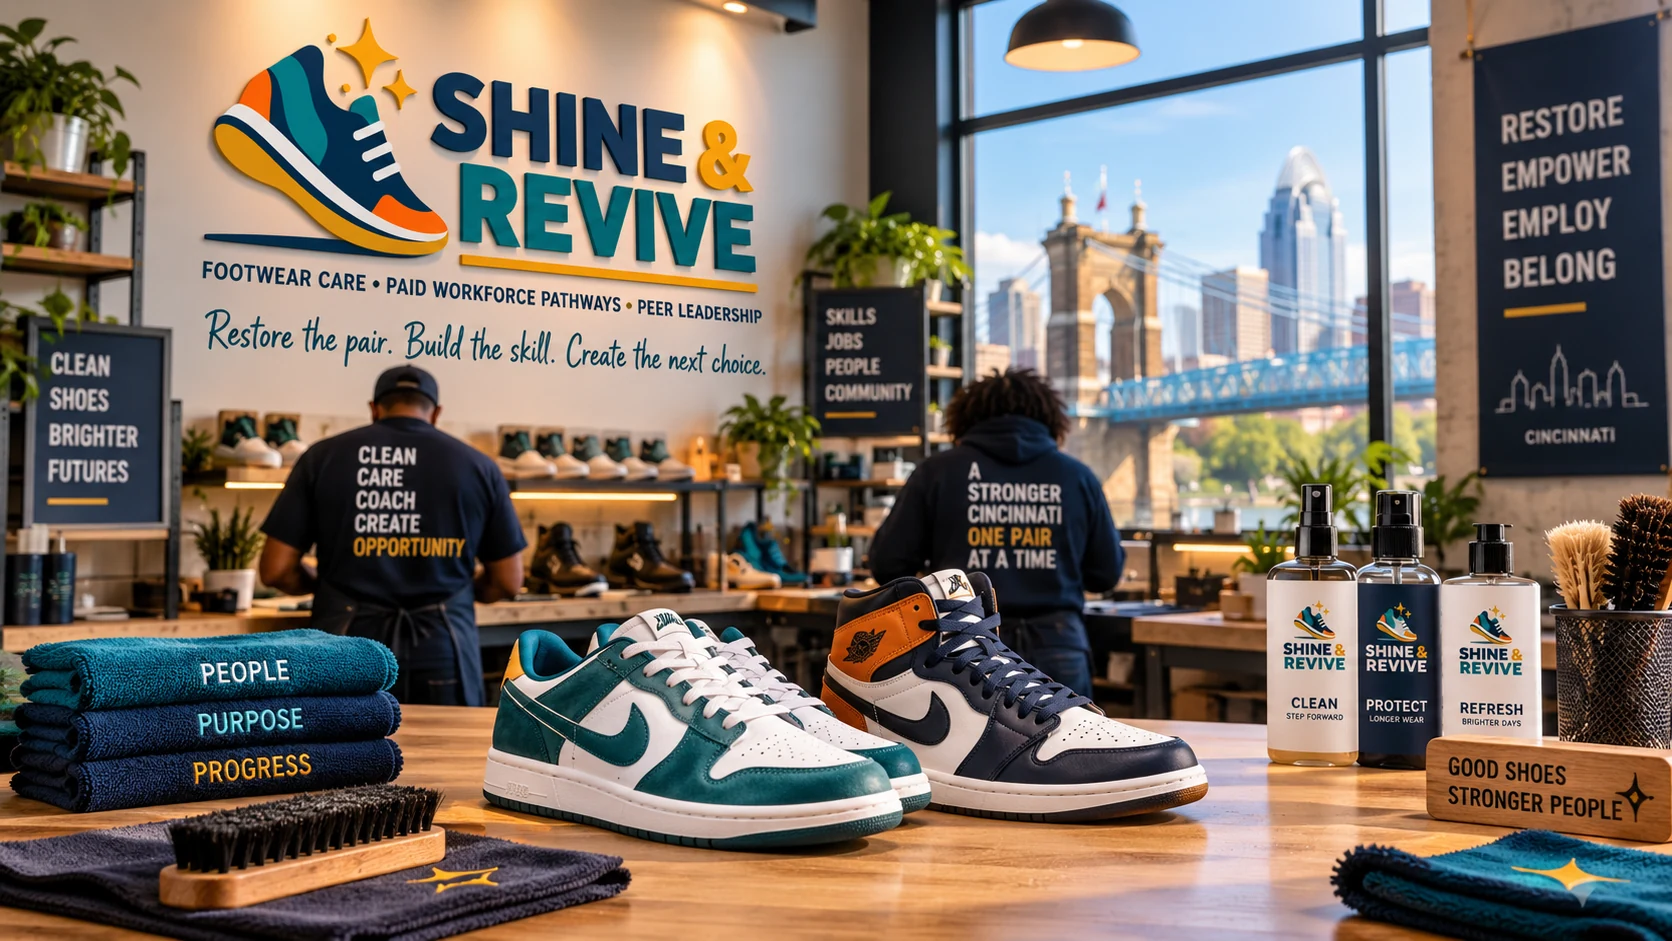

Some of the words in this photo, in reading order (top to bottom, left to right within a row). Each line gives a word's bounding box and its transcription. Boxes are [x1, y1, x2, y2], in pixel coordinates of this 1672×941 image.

[1502, 95, 1623, 144] RESTORE
[431, 72, 686, 183] SHINE
[698, 120, 754, 192] &
[1502, 145, 1630, 192] EMPOWER
[460, 162, 756, 272] REVIVE
[1503, 197, 1611, 240] EMPLOY
[1504, 248, 1615, 289] BELONG
[203, 261, 311, 287] FOOTWEAR
[319, 271, 366, 291] CARE
[387, 277, 426, 296] PAID
[433, 281, 535, 305] WORKFORCE
[542, 291, 621, 312] PATHWAYS
[638, 299, 673, 317] PEER
[679, 303, 762, 324] LEADERSHIP
[826, 308, 876, 325] SKILLS
[205, 309, 293, 350] Restore
[302, 317, 337, 352] the
[344, 331, 392, 367] pair.
[404, 321, 464, 360] Build
[470, 327, 502, 361] the
[510, 330, 555, 364] skill.
[567, 333, 626, 369] Create
[633, 338, 662, 370] the
[669, 345, 707, 373] next
[712, 344, 766, 375] choice.
[825, 332, 863, 350] JOBS
[51, 352, 110, 377] CLEAN
[826, 358, 880, 375] PEOPLE
[50, 387, 109, 412] SHOES
[825, 383, 912, 401] COMMUNITY
[49, 423, 138, 447] BRIGHTER
[1525, 427, 1615, 444] CINCINNATI
[359, 446, 416, 465] CLEAN
[48, 459, 128, 483] FUTURES
[357, 467, 403, 487] CARE
[968, 462, 981, 480] A
[356, 490, 416, 510] COACH
[968, 483, 1061, 503] STRONGER
[355, 513, 421, 533] CREATE
[968, 505, 1061, 524] CINCINNATI
[968, 527, 1004, 546] ONE
[1011, 527, 1051, 546] PAIR
[354, 537, 465, 557] OPPORTUNITY
[968, 549, 991, 568] AT
[995, 549, 1008, 568] A
[1014, 549, 1056, 569] TIME
[1284, 643, 1331, 655] SHINE
[1335, 644, 1345, 656] &
[1366, 645, 1414, 657] SHINE
[1417, 646, 1427, 658] &
[1459, 647, 1508, 660] SHINE
[1511, 649, 1522, 661] &
[200, 660, 289, 685] PEOPLE
[1285, 657, 1345, 670] REVIVE
[1367, 659, 1427, 672] REVIVE
[1460, 661, 1522, 675] REVIVE
[1292, 697, 1337, 709] CLEAN
[1367, 699, 1427, 712] PROTECT
[1461, 702, 1523, 715] REFRESH
[198, 708, 303, 735] PURPOSE
[1462, 718, 1499, 726] BRIGHTER
[193, 754, 311, 784] PROGRESS
[1449, 757, 1498, 778] GOOD
[1506, 761, 1566, 785] SHOES
[1448, 786, 1543, 813] STRONGER
[1551, 795, 1622, 821] PEOPLE
